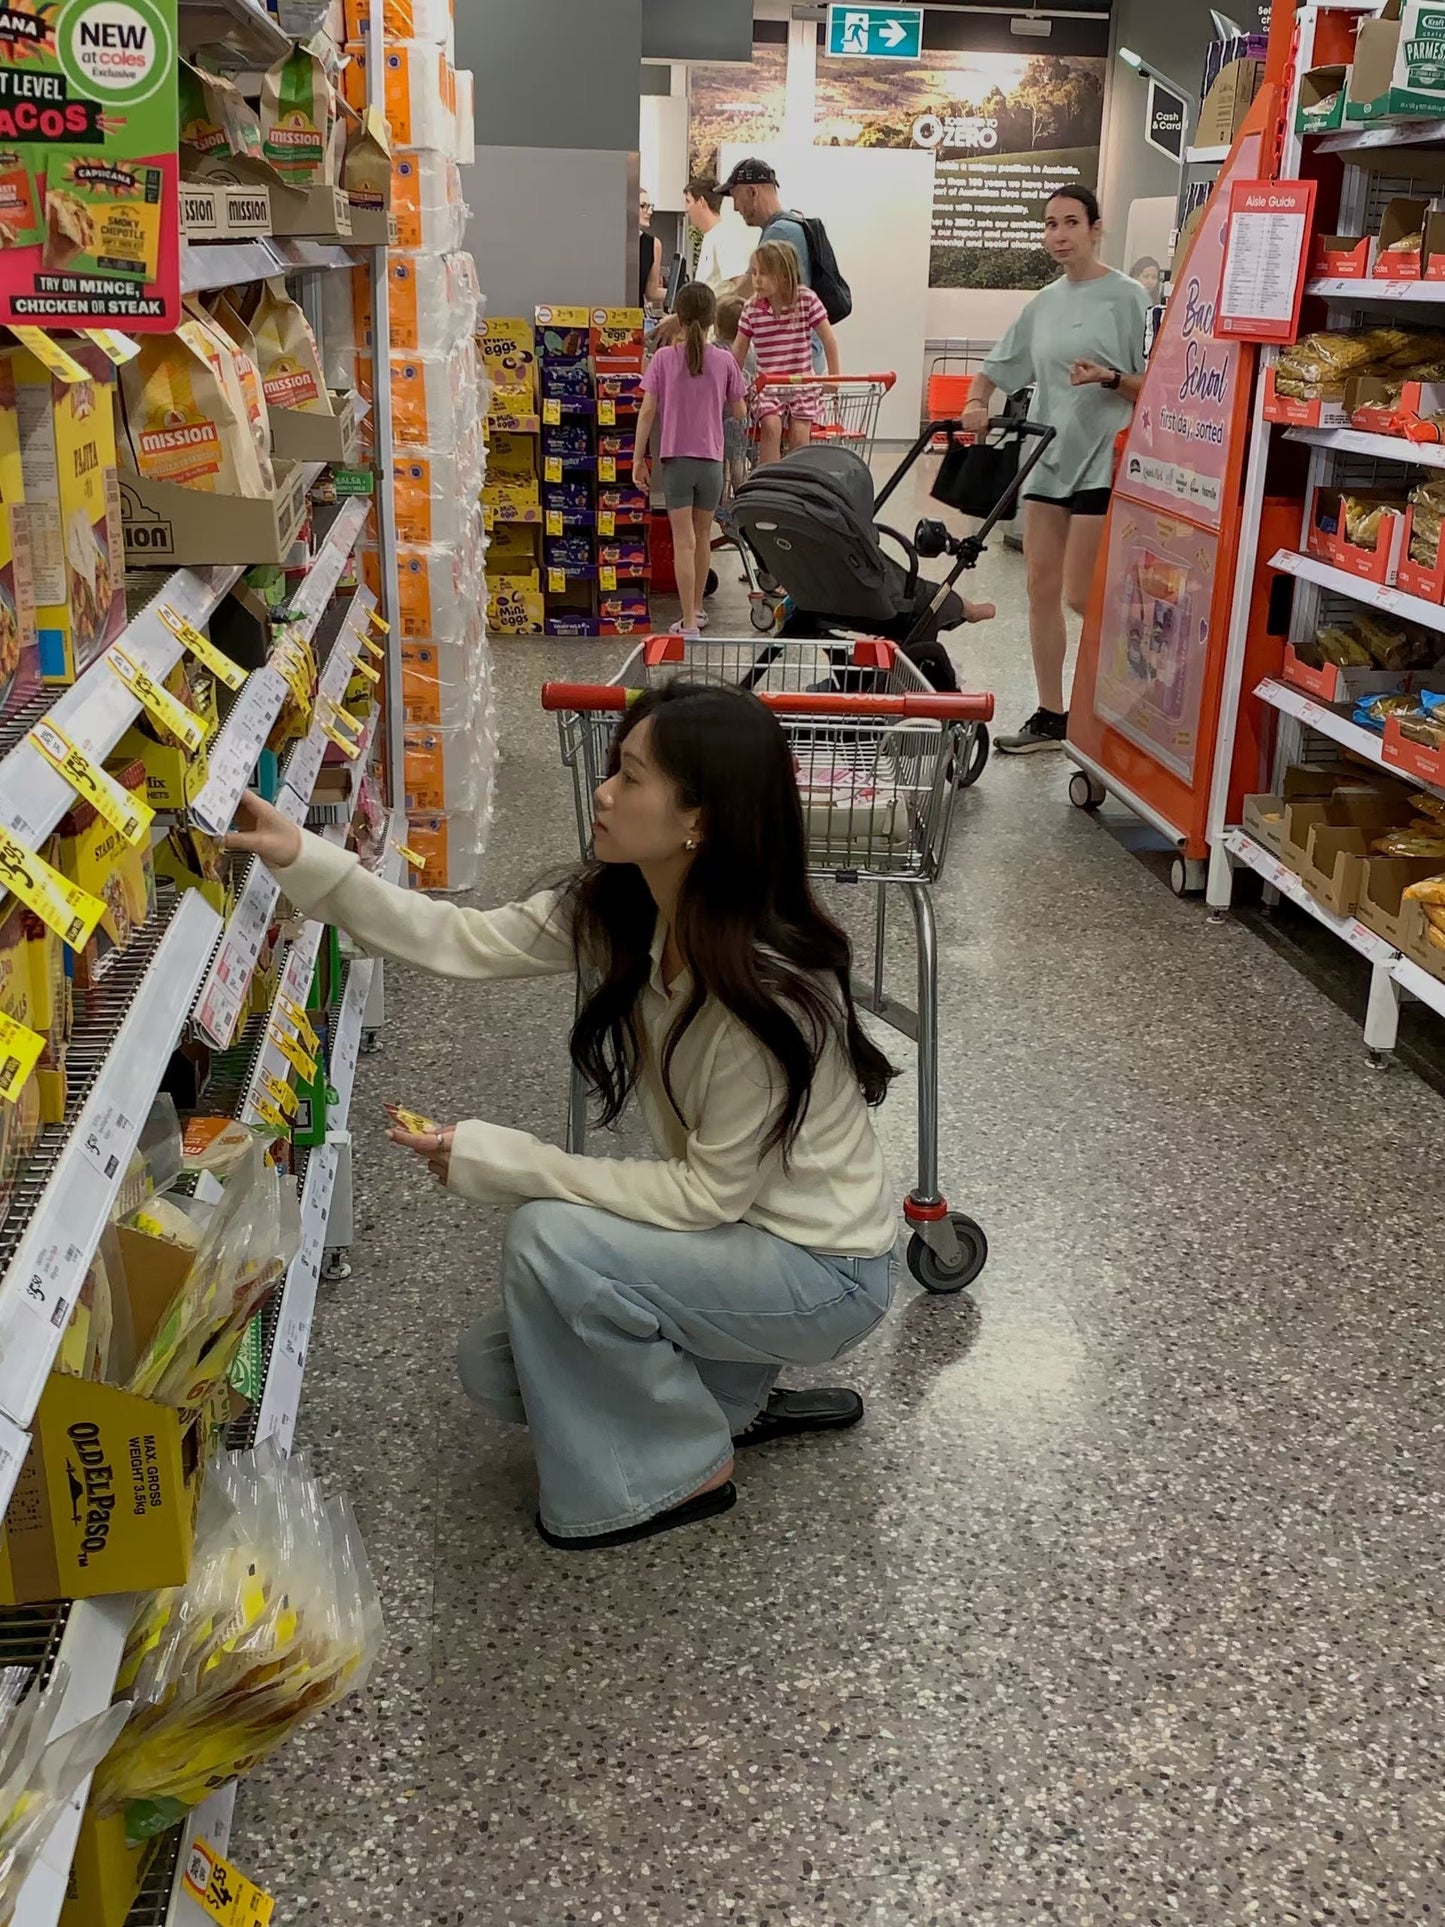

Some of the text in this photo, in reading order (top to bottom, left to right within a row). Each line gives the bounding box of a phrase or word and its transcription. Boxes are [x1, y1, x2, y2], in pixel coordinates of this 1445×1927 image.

[80, 21, 147, 50] NEW
[82, 50, 146, 67] at coles
[92, 66, 137, 79] Exclusive
[13, 73, 63, 101] LEVEL
[1156, 111, 1179, 122] Cash
[1159, 120, 1182, 131] Card
[943, 127, 998, 149] ZERO
[955, 203, 973, 212] with
[1245, 195, 1296, 208] Aisle Guide
[954, 218, 976, 227] ZERO
[40, 276, 140, 298] TRY ON MINCE,
[15, 299, 161, 315] CHICKEN OR STEAK
[607, 331, 627, 342] egg
[484, 340, 517, 357] eggs
[1179, 339, 1228, 404] School
[1160, 407, 1176, 431] first
[1195, 421, 1223, 444] sorted
[500, 604, 525, 618] Mini
[501, 614, 529, 627] eggs
[66, 1422, 105, 1466] OLD
[128, 1436, 148, 1517] WEIGHT 3.5kg
[143, 1434, 162, 1508] MAX. GROSS
